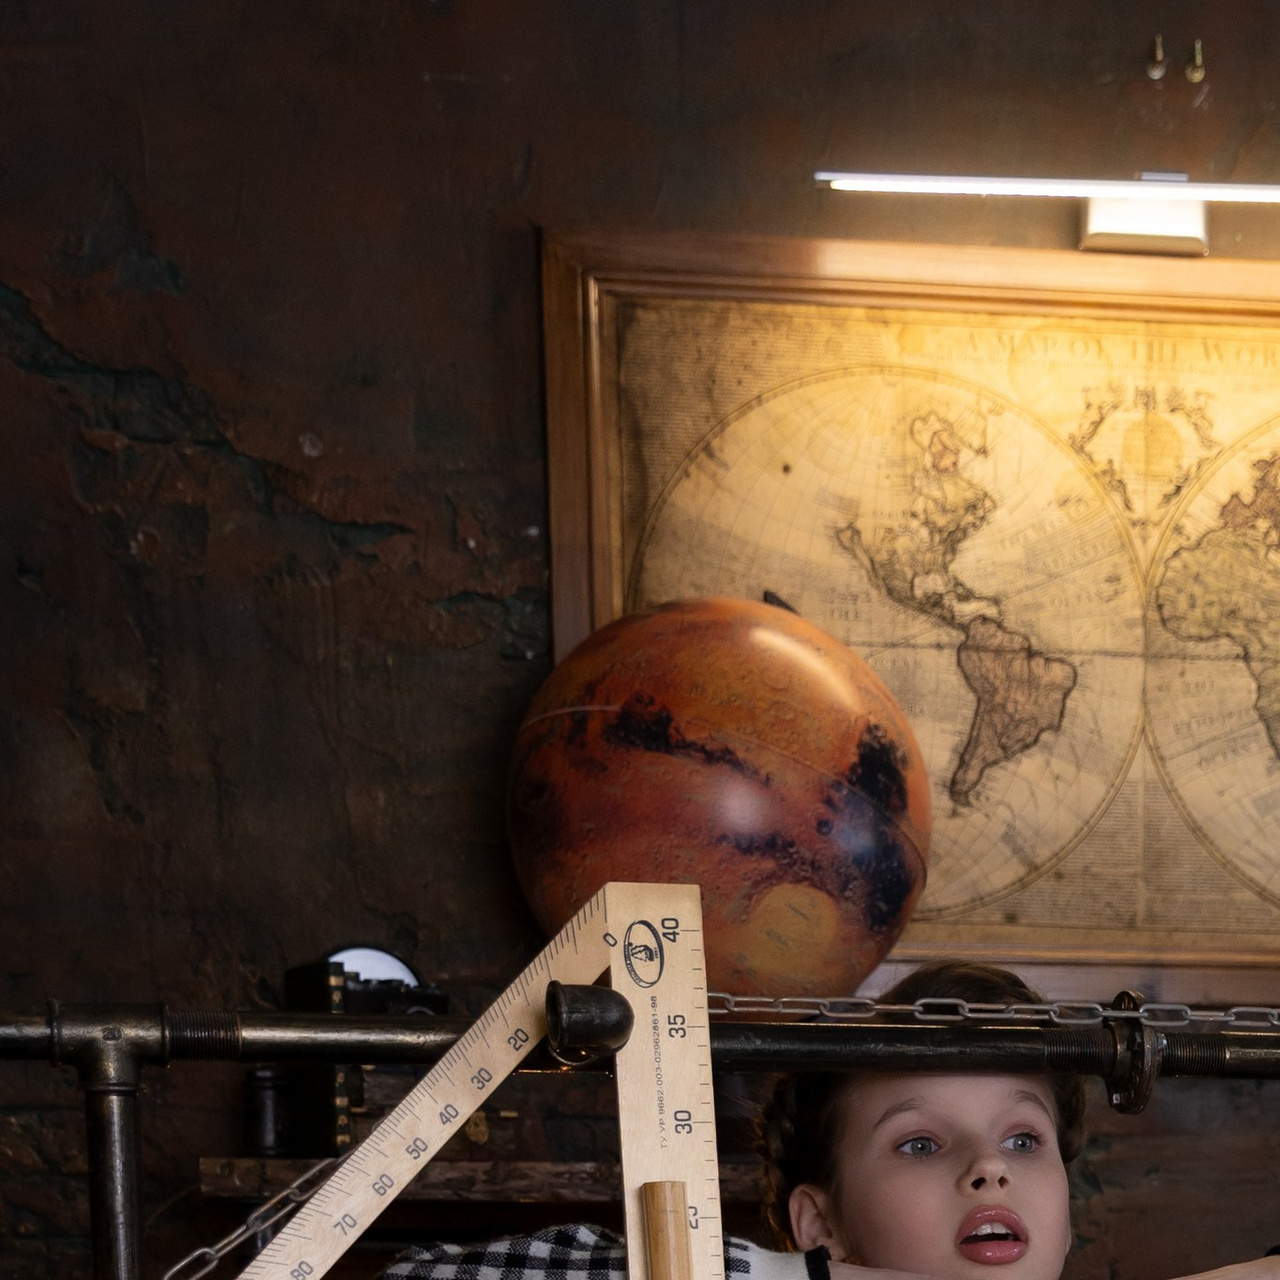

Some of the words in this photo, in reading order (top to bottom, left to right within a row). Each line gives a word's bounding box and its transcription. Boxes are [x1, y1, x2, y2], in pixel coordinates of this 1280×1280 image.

[603, 932, 617, 947] 0
[662, 917, 680, 943] 40
[668, 1014, 686, 1038] 35
[507, 1027, 530, 1051] 20
[470, 1067, 493, 1090] 30
[438, 1104, 460, 1126] 40
[674, 1109, 692, 1134] 30
[405, 1137, 429, 1160] 50
[372, 1173, 395, 1196] 60
[333, 1213, 357, 1236] 70
